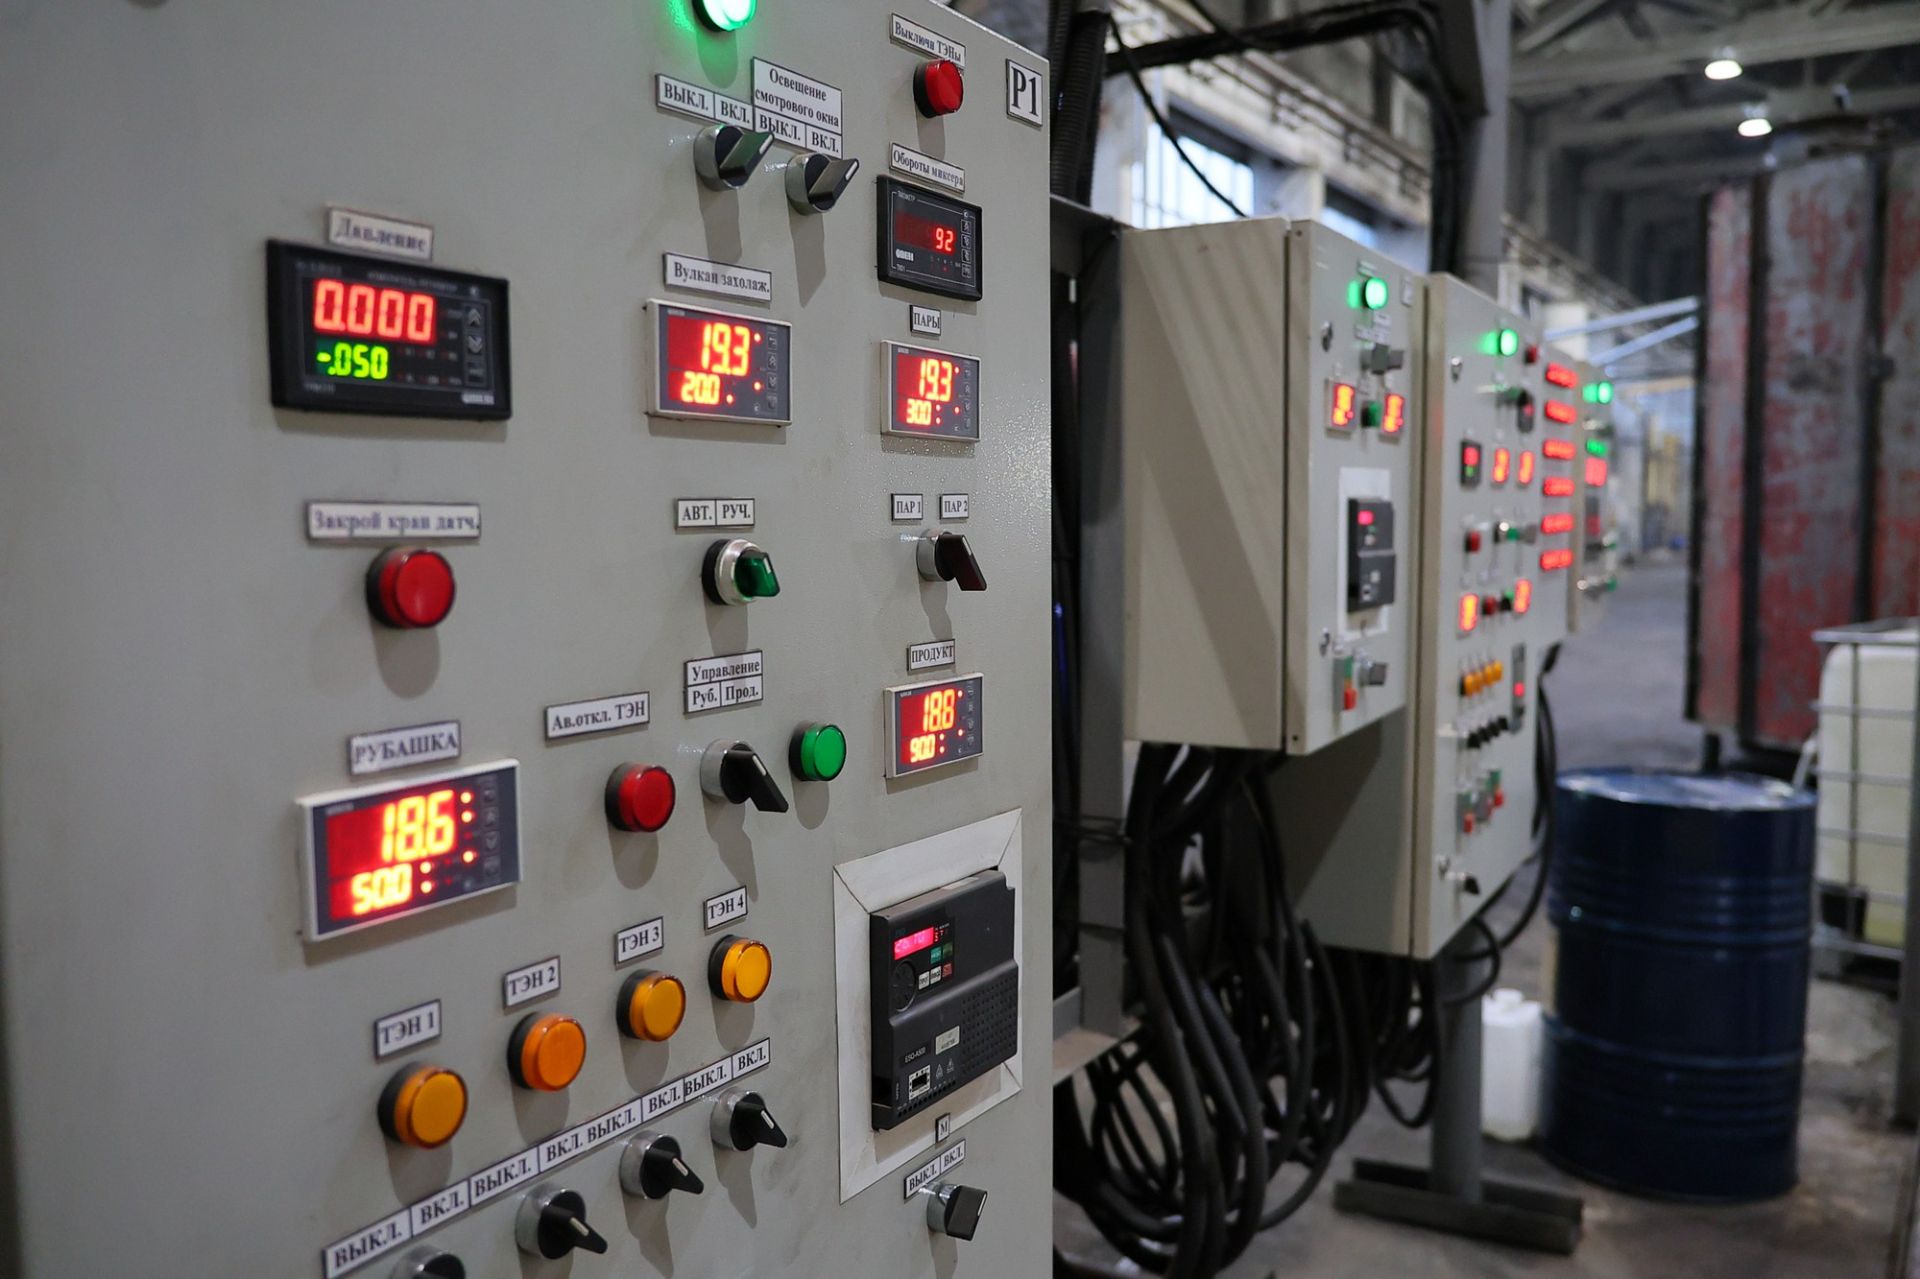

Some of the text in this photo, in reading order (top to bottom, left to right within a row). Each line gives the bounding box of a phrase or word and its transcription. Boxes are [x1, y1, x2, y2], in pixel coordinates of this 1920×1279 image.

[894, 22, 962, 63] Выключи ТЭНы
[768, 68, 828, 102] Освещение
[663, 83, 751, 125] ВЫКЛ. ВКЛ.
[755, 88, 840, 128] смотрового окна
[758, 113, 840, 154] ВЫКЛ. ВКЛ.
[893, 150, 965, 188] Обороты миксера
[335, 217, 427, 253] Давление
[935, 227, 954, 252] 92
[673, 261, 770, 295] Вулкан захолаж.
[314, 279, 434, 342] 0.000
[913, 311, 940, 331] ПАРЫ
[701, 322, 751, 376] 19.3
[919, 358, 953, 402] 19.3
[682, 504, 751, 521] АВТ. РУЧ.
[895, 499, 922, 514] ПАР 1
[943, 499, 969, 513] ПАР 2
[314, 510, 480, 536] Закрой кран датч.
[911, 644, 955, 664] ПРОДУКТ
[692, 660, 760, 682] Управление
[692, 685, 759, 708] Руб. Прод.
[552, 700, 646, 732] Ав.откл. ТЭН
[353, 732, 458, 765] РУБАШКА
[380, 788, 455, 863] 18.6
[708, 892, 745, 920] ТЭН 4
[619, 926, 661, 953] ТЭН 3
[509, 965, 557, 996] ТЭН 2
[379, 1011, 437, 1045] ТЭН 1
[939, 1121, 949, 1135] М
[334, 1047, 767, 1269] ВЫКЛ. ВКЛ. ВЫКЛ. ВКЛ. ВЫКЛ. ВКЛ. ВЫКЛ. ВКЛ.
[908, 1147, 963, 1193] ВЫКЛ. ВКЛ.
